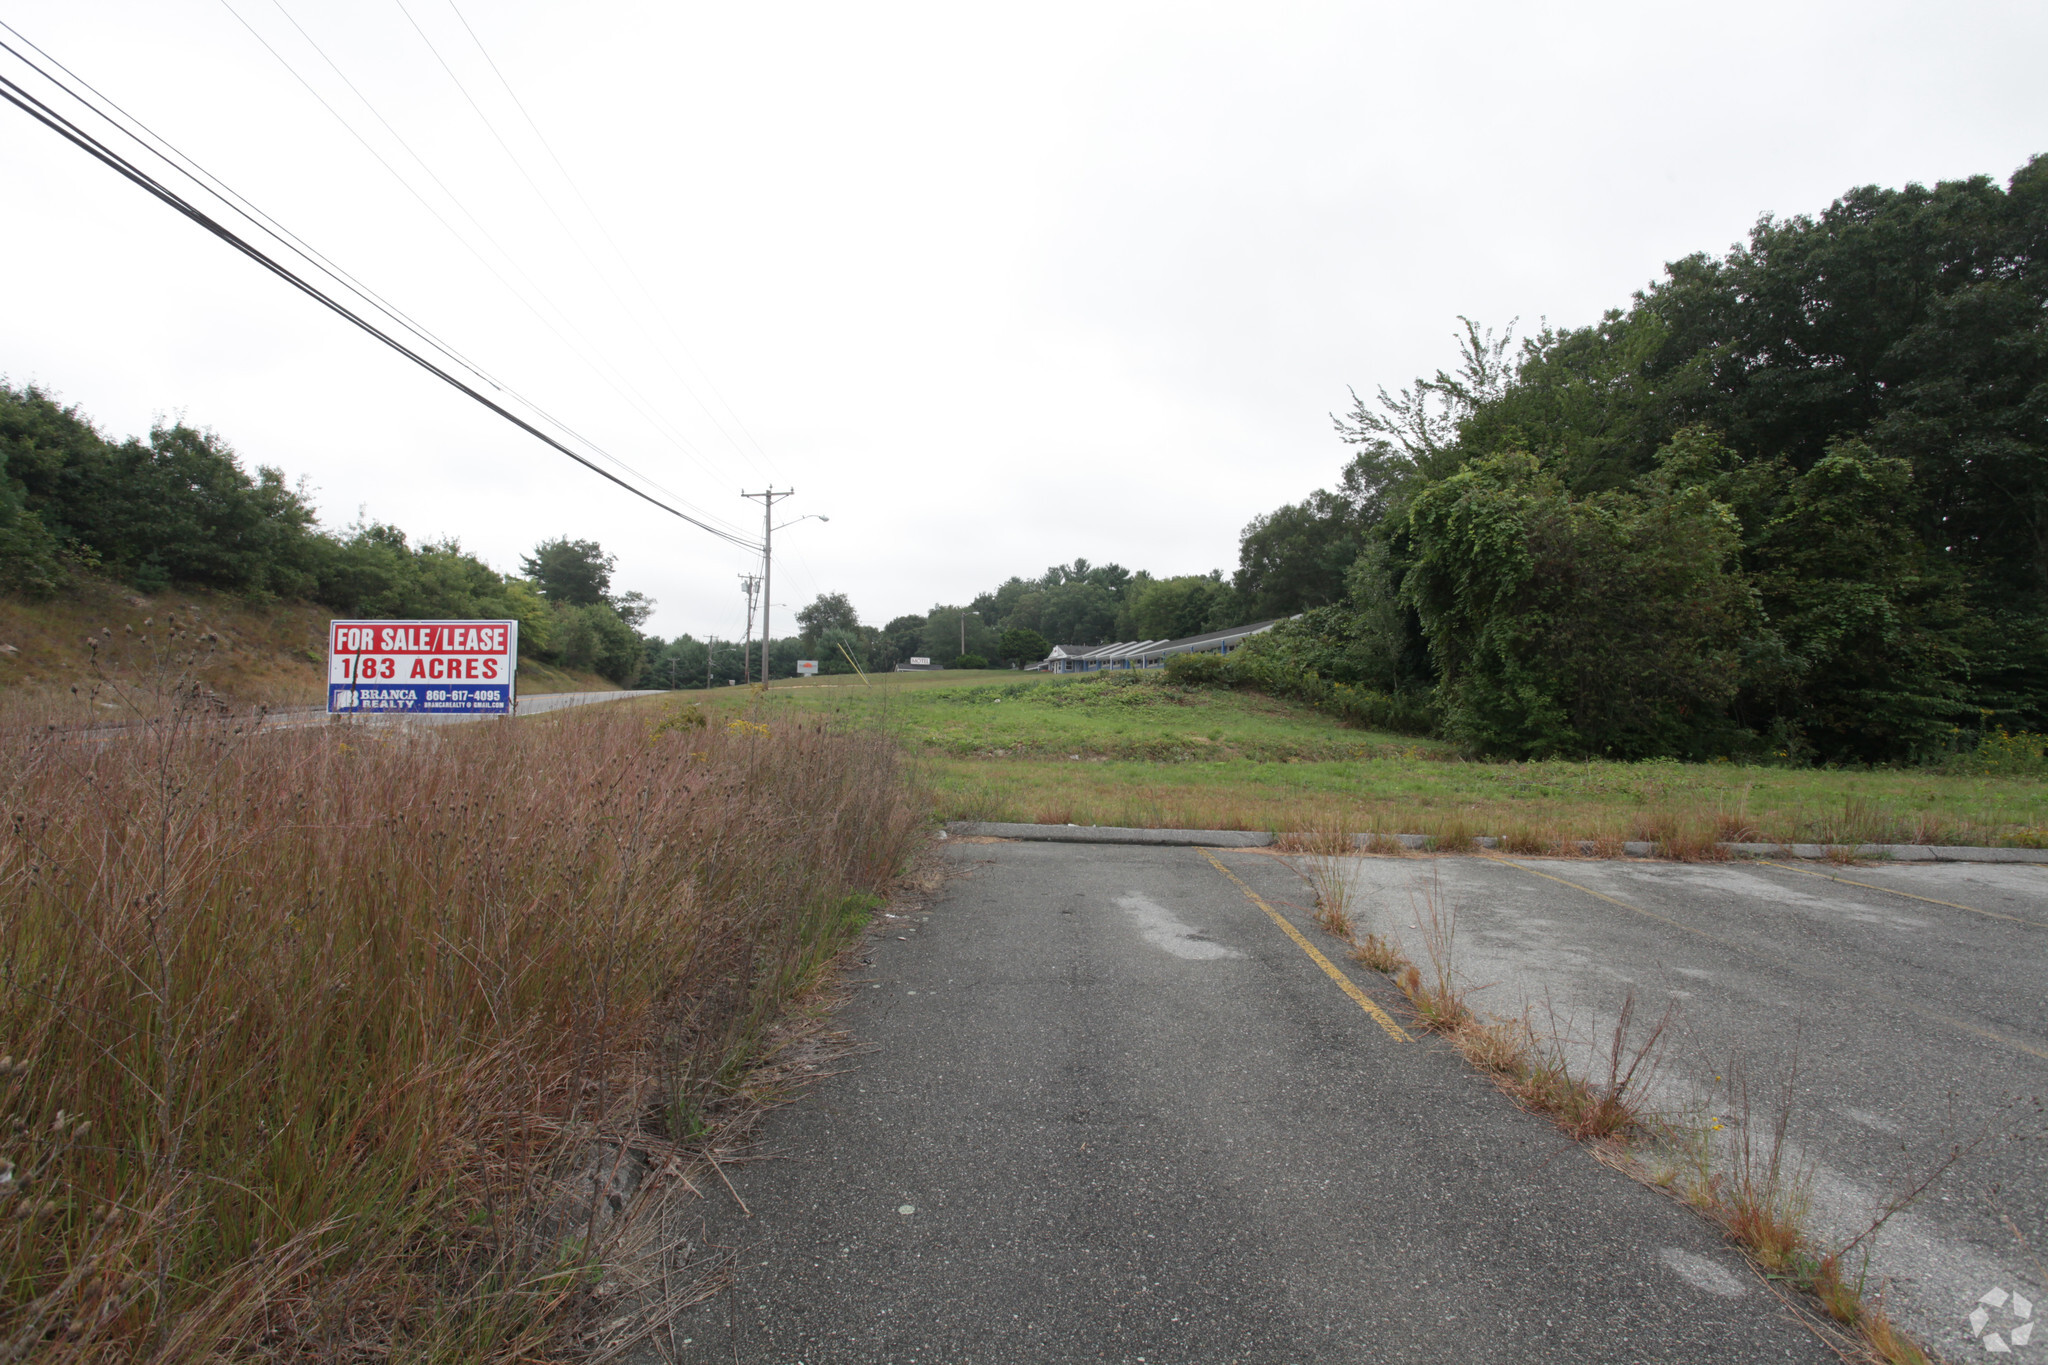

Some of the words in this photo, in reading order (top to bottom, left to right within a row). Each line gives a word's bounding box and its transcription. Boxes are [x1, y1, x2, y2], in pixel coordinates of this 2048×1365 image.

[337, 628, 374, 650] FOR
[381, 627, 504, 651] SALE/LEASE
[410, 658, 498, 679] ACRES
[360, 689, 417, 700] BRANCA
[426, 690, 500, 701] 860-617-4095
[362, 700, 415, 708] REALTY
